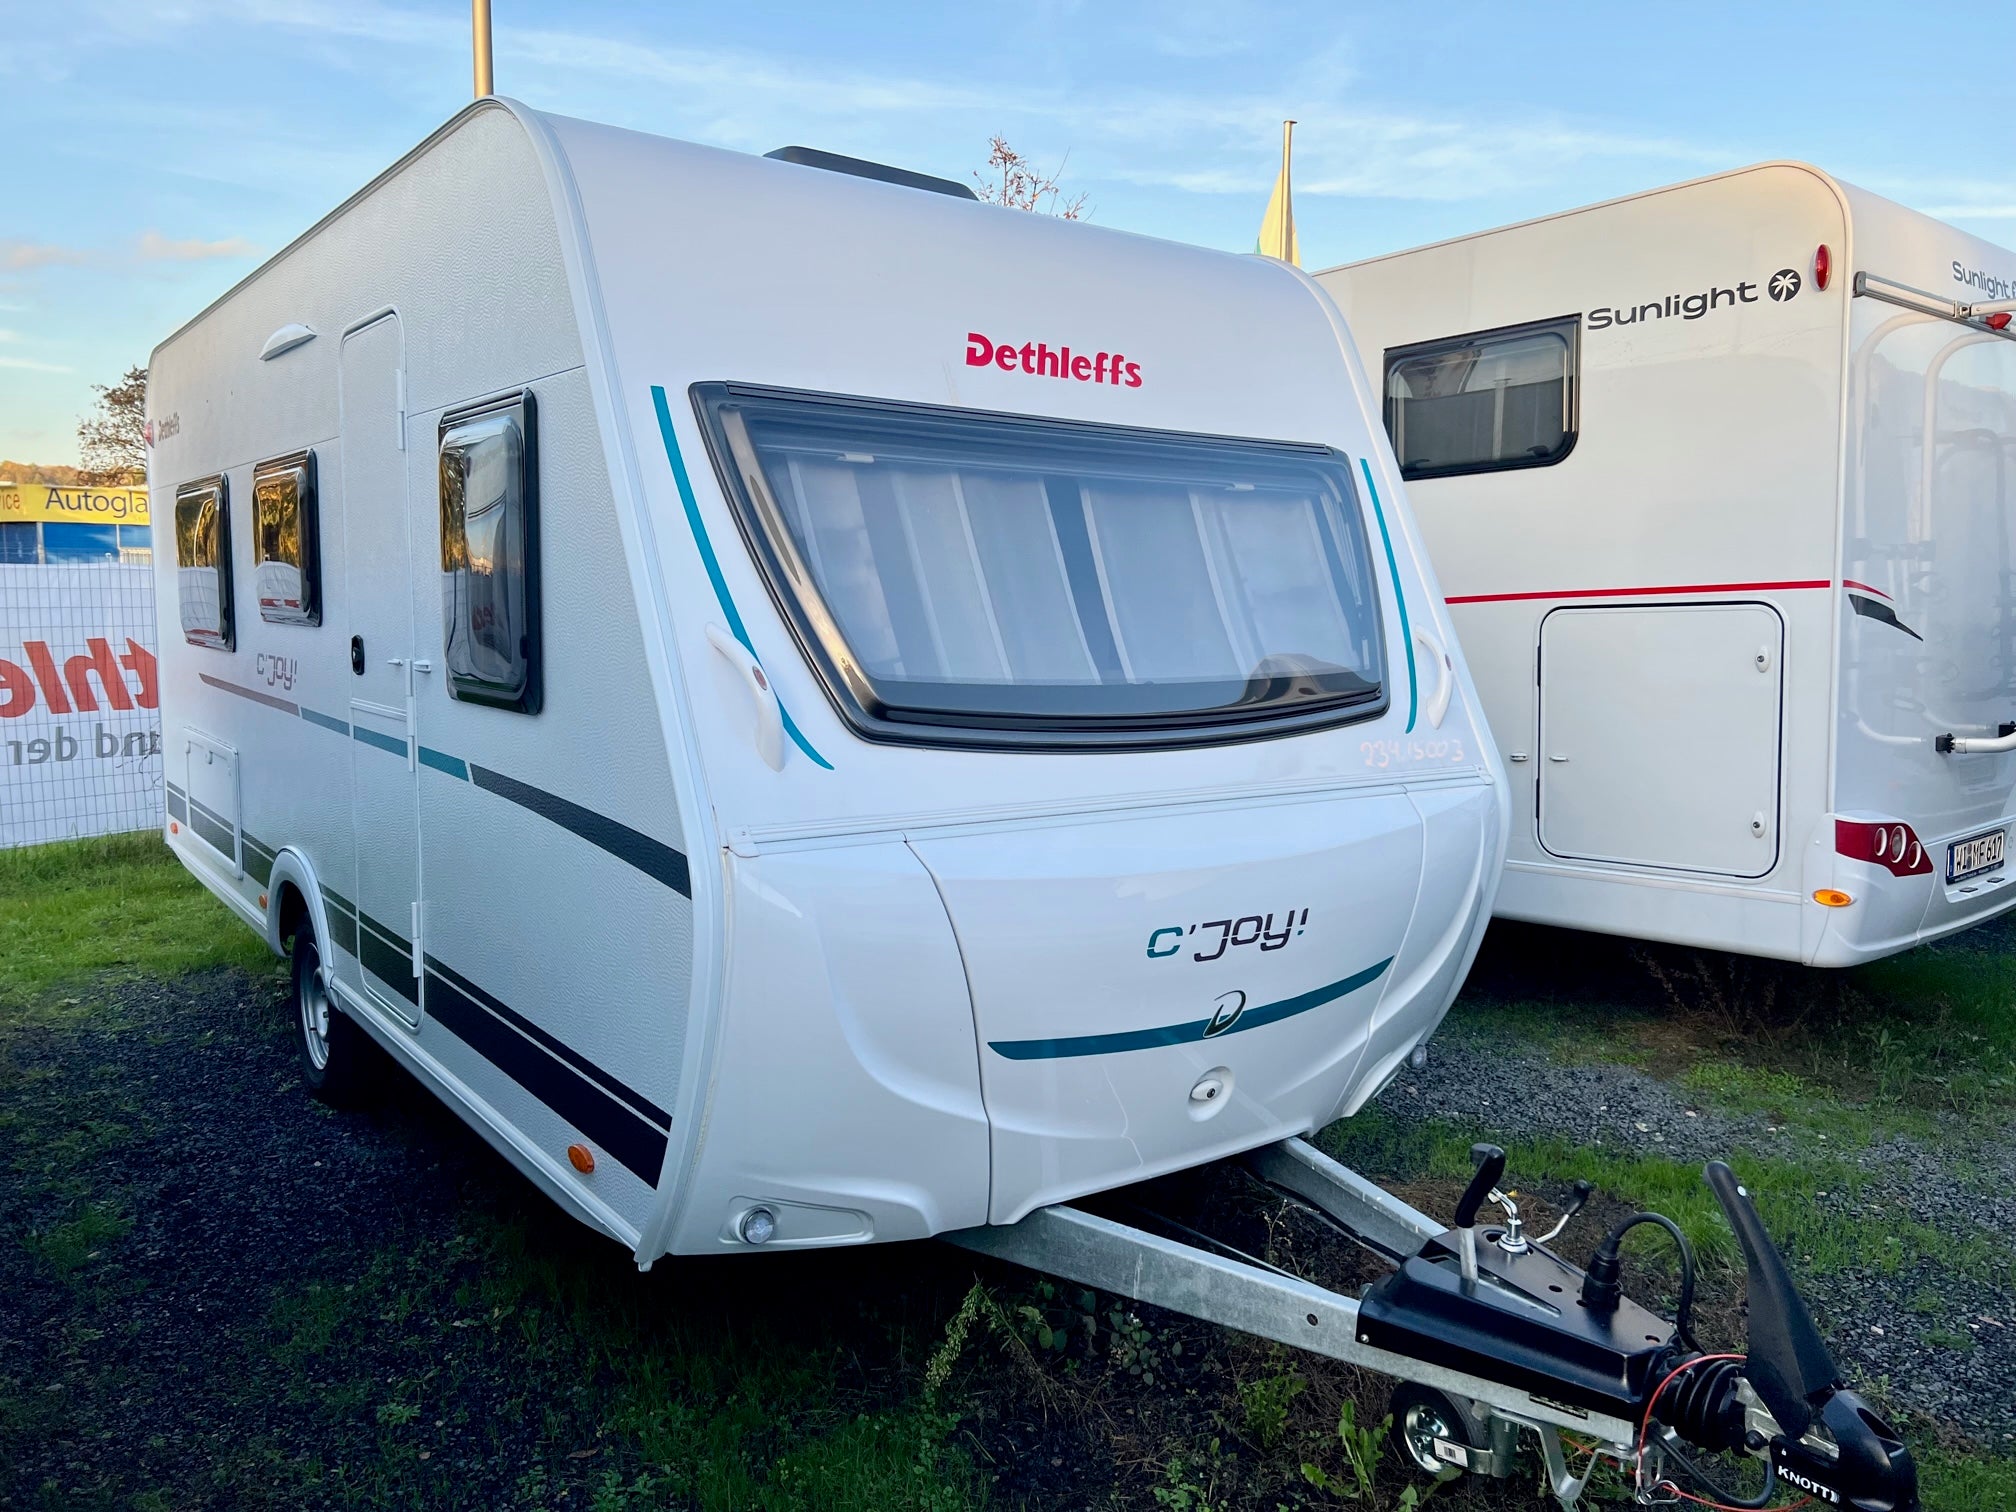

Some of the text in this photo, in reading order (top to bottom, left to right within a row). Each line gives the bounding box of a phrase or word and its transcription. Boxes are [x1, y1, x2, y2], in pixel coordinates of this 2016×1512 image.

[1951, 260, 2011, 300] Sunlight
[1587, 281, 1759, 330] Sunlight
[965, 332, 1143, 388] Dethleffs
[0, 491, 21, 510] ice
[45, 487, 149, 518] Autogla
[1986, 835, 2002, 862] 617
[1777, 1465, 1830, 1499] KNOTT
